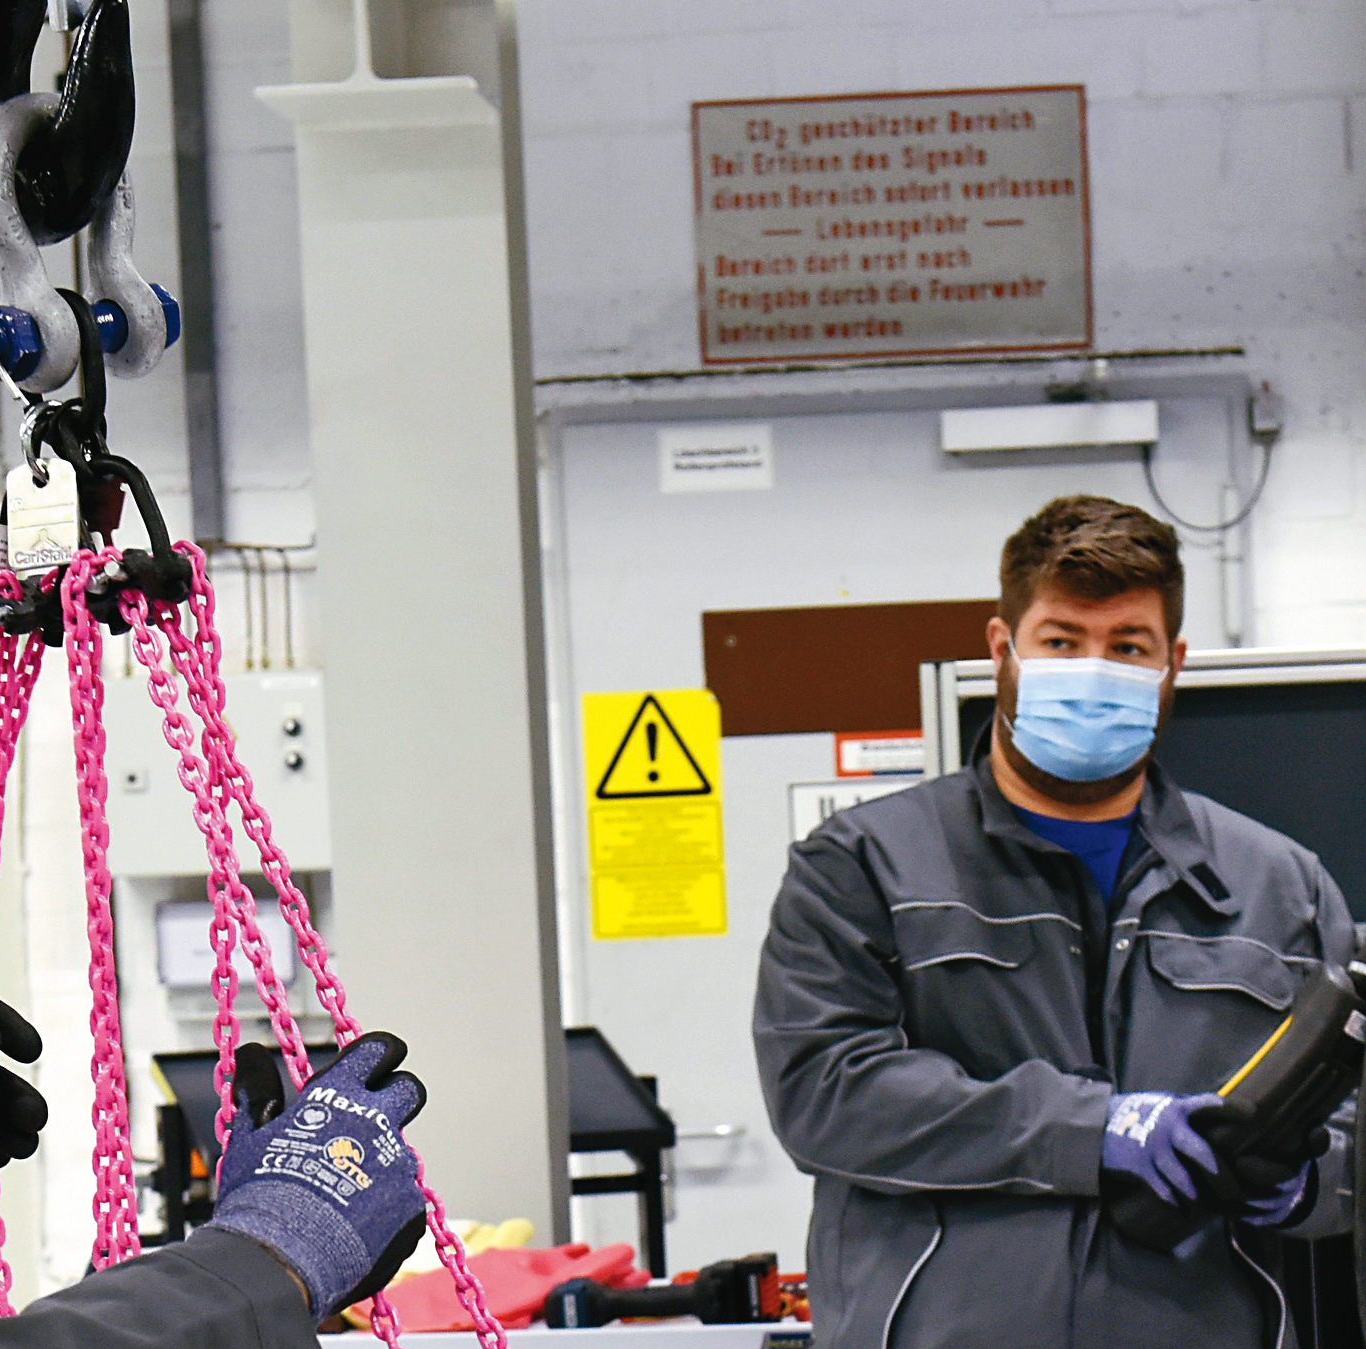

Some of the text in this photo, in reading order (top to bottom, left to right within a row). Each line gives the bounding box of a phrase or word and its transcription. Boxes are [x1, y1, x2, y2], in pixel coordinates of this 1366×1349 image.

[949, 109, 1036, 134] Bereich
[711, 153, 744, 177] Bei
[852, 148, 890, 171] des
[903, 144, 988, 174] Signals
[711, 175, 1076, 211] diesen Bereich sofort verlassen
[816, 213, 970, 243] Lebensgefahr
[714, 245, 973, 278] Bereich darf erst nach
[716, 276, 1047, 314] Freigabe durch die Feuerwehr
[718, 316, 903, 345] betreten werden
